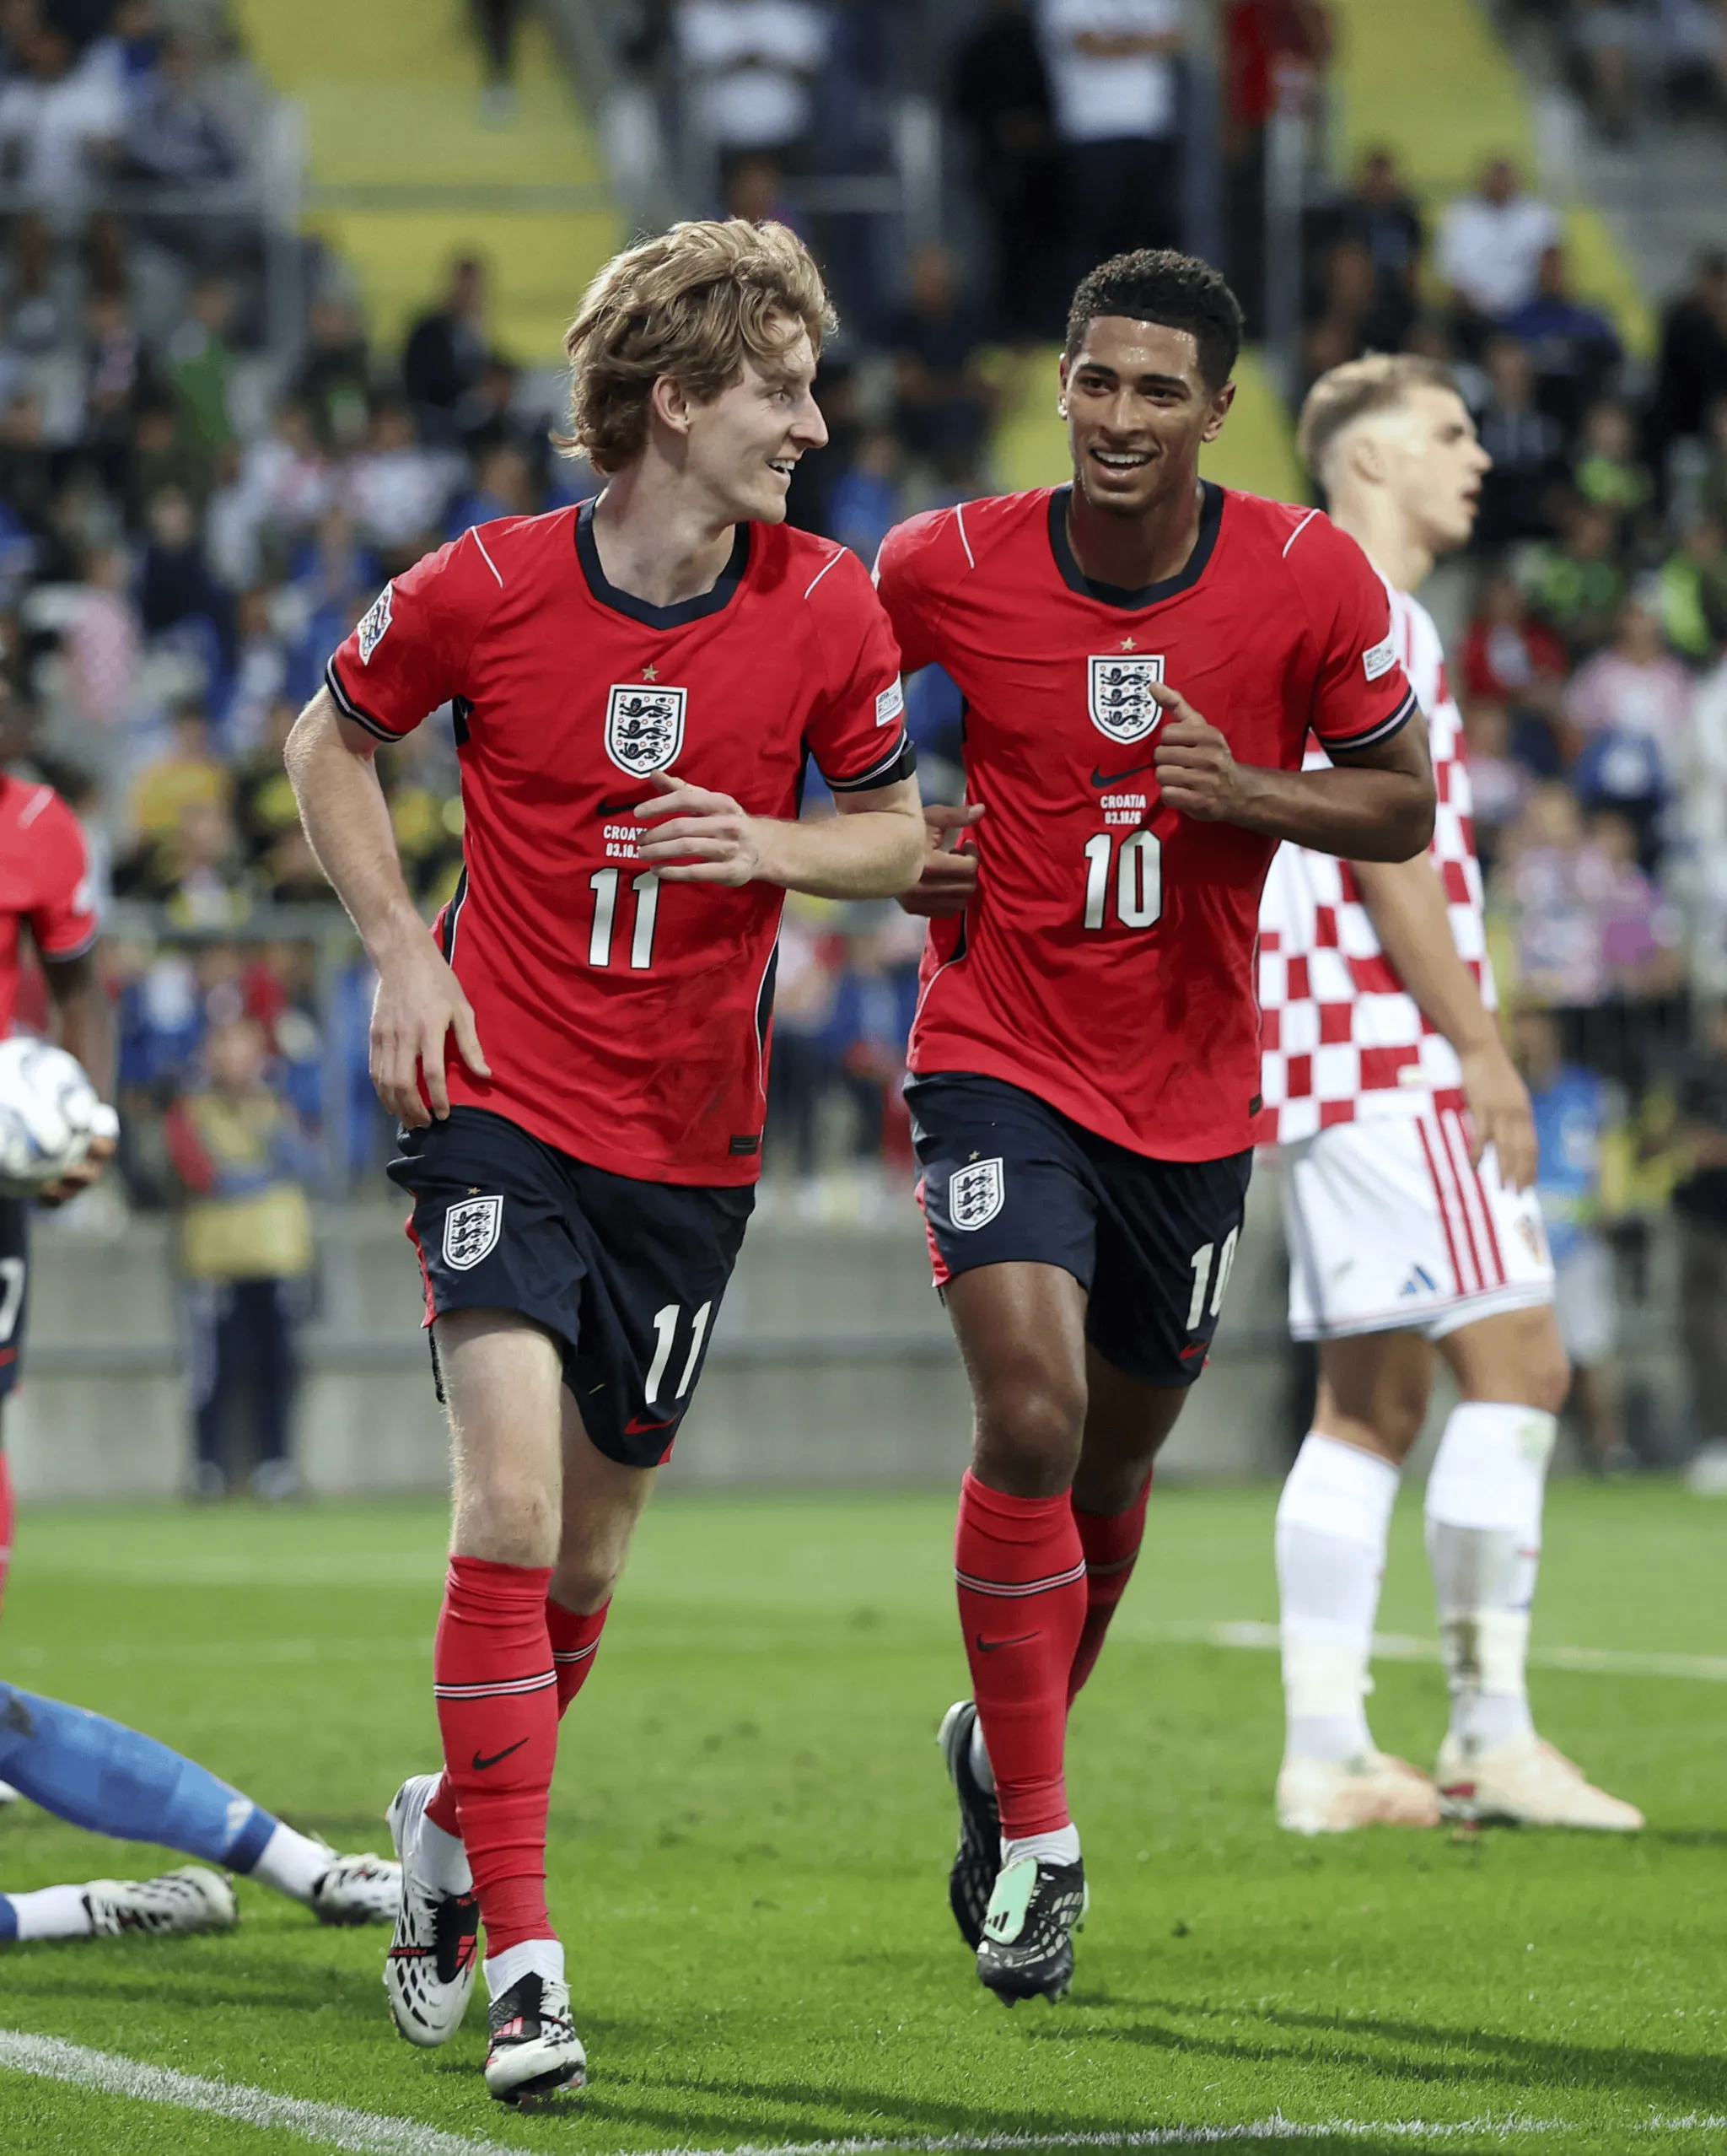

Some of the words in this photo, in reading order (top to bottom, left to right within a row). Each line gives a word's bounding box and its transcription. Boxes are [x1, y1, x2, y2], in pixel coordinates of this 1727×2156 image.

[1100, 794, 1146, 809] CROATIA
[588, 867, 661, 970] 11
[1084, 829, 1162, 930] 10
[1186, 1224, 1239, 1331] 10
[645, 1300, 712, 1405] 11
